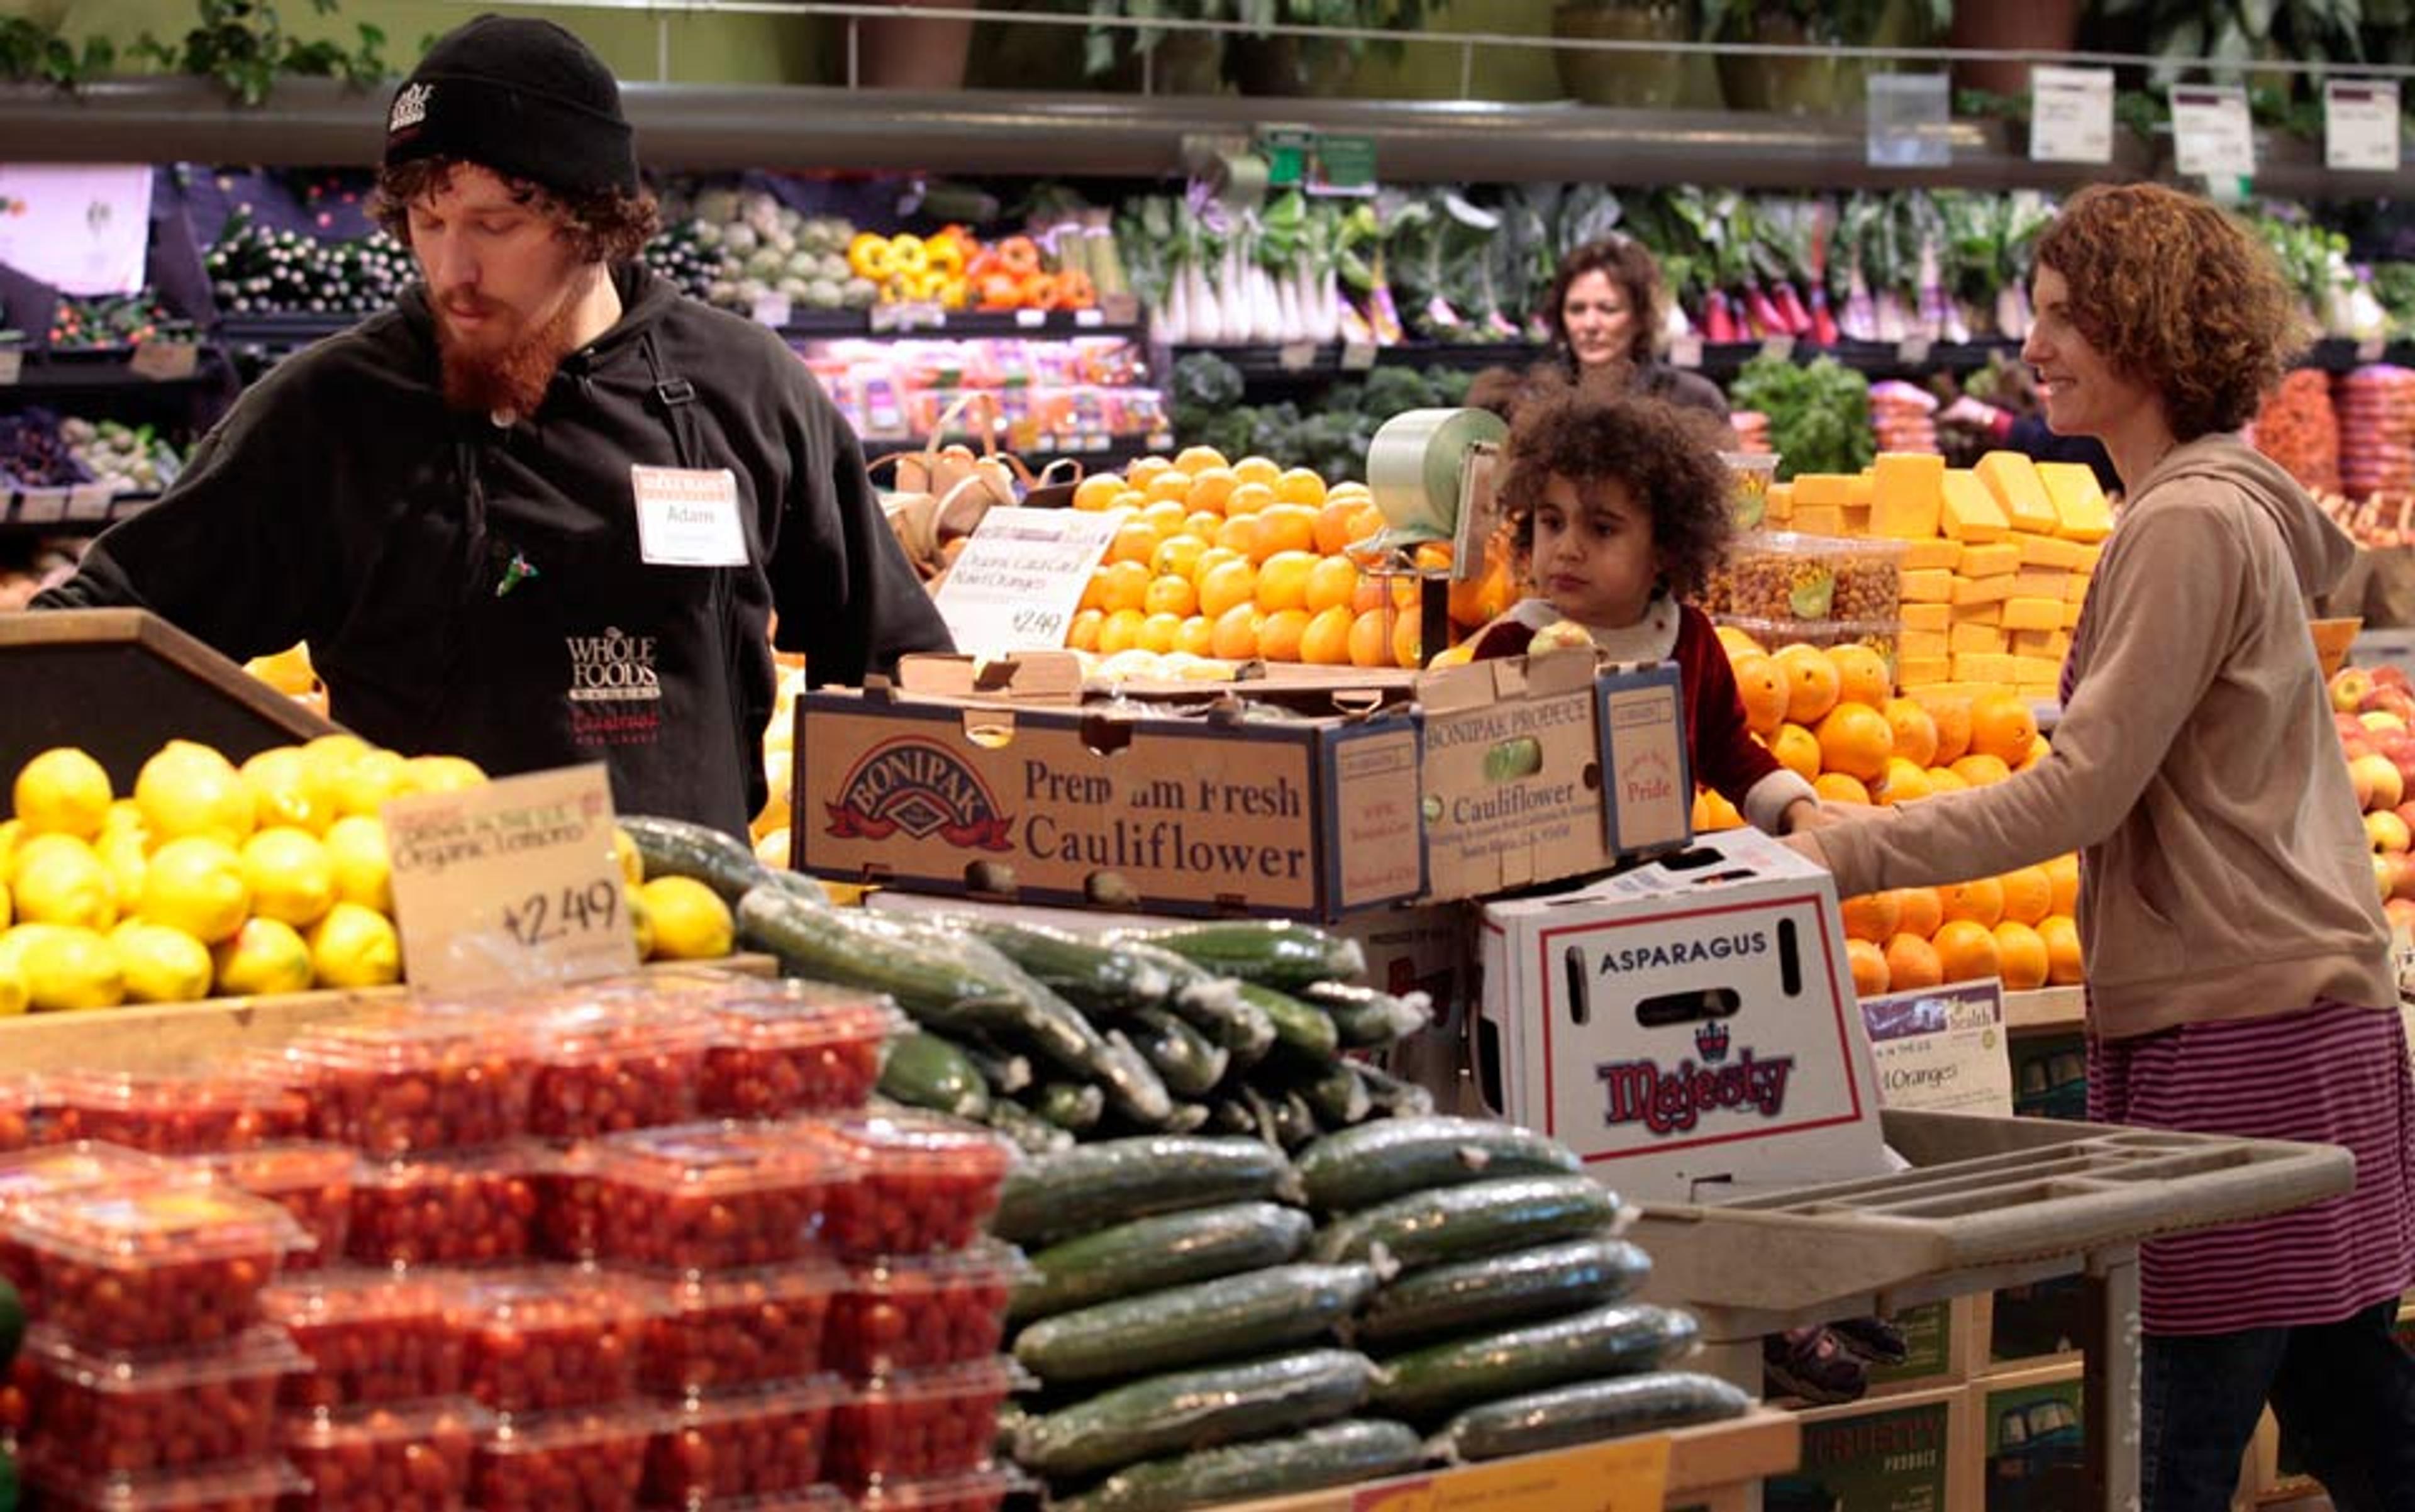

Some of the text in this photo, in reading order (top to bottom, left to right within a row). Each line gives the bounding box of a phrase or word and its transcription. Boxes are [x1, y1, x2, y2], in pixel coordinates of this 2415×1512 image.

[667, 505, 716, 524] Adam
[567, 636, 657, 662] WHOLE
[574, 662, 658, 687] FOODS
[851, 751, 976, 826] BONIPAK
[1024, 759, 1185, 810] Premum
[1453, 784, 1575, 824] Cauliflower
[1627, 777, 1671, 803] Pride
[1025, 815, 1306, 879] Cauliflower
[505, 879, 618, 947] $2.49
[1600, 932, 1768, 975] ASPARAGUS
[1596, 1047, 1796, 1135] Majesty
[1891, 1063, 1959, 1092] Oranges
